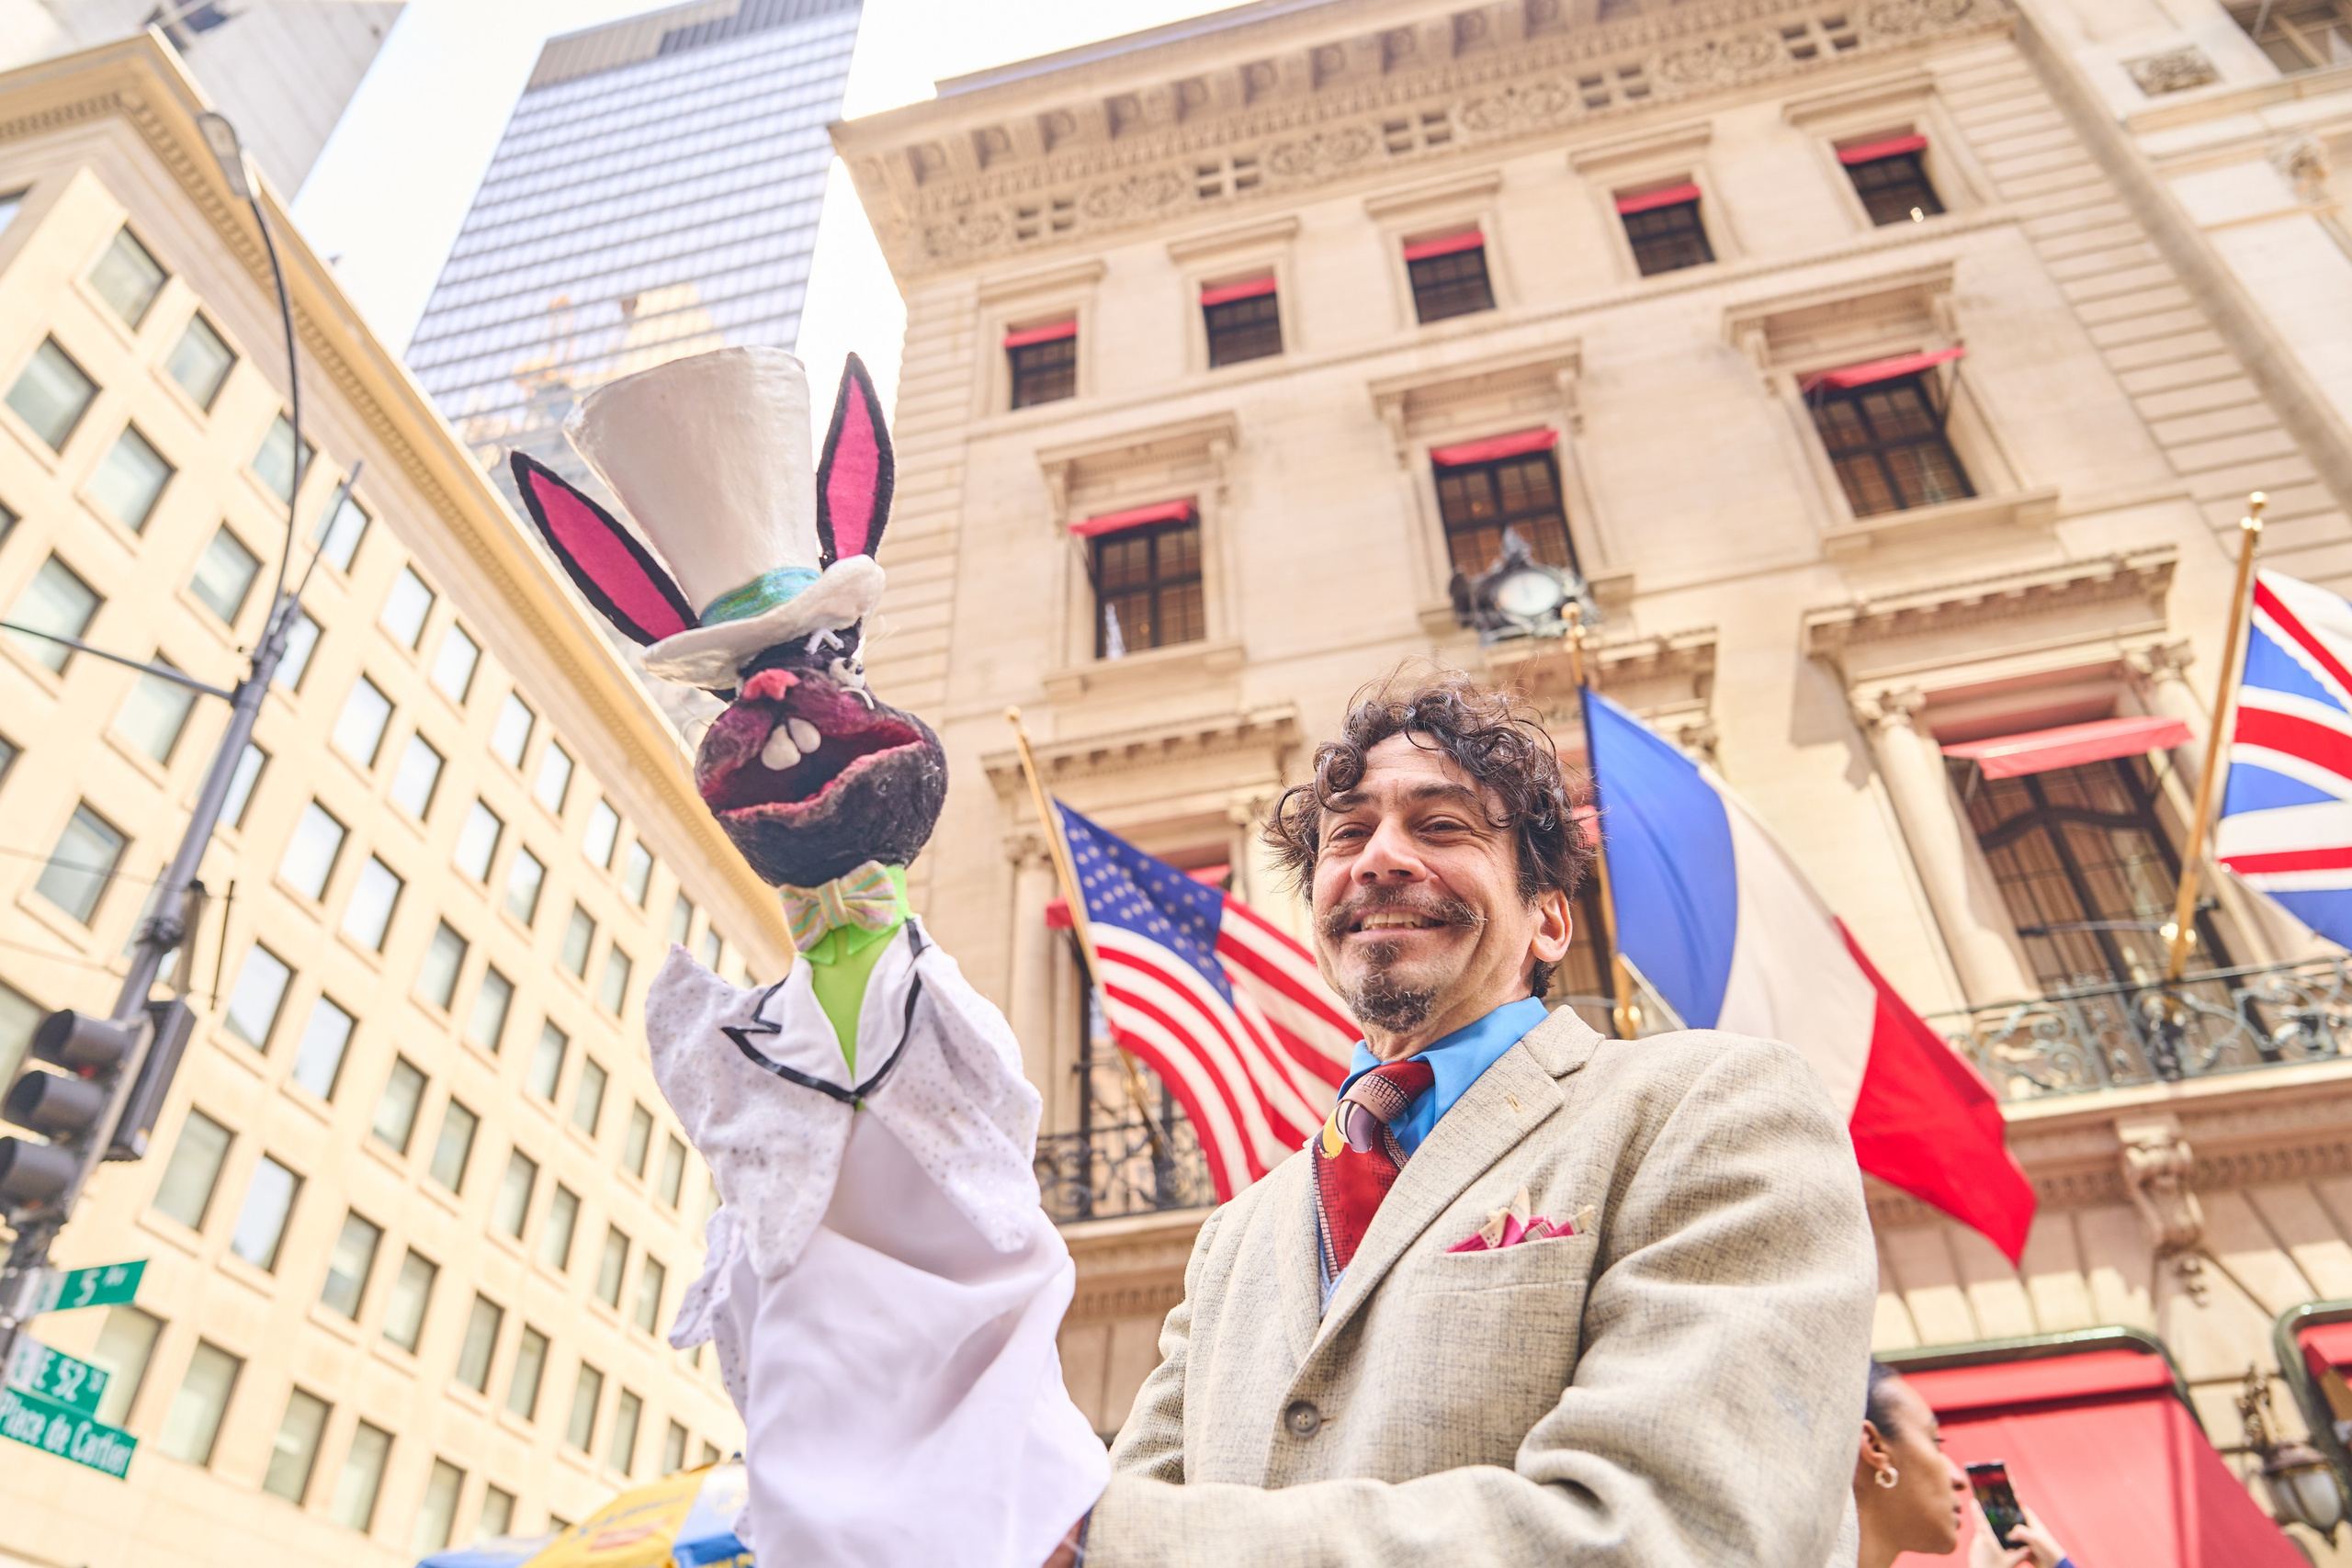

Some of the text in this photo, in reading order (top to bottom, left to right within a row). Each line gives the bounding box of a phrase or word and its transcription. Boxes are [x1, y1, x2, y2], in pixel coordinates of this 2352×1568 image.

[74, 1267, 101, 1307] 5
[32, 1348, 57, 1390] E
[51, 1357, 87, 1403] 52
[43, 1413, 72, 1455] de
[70, 1419, 132, 1477] Cartier
